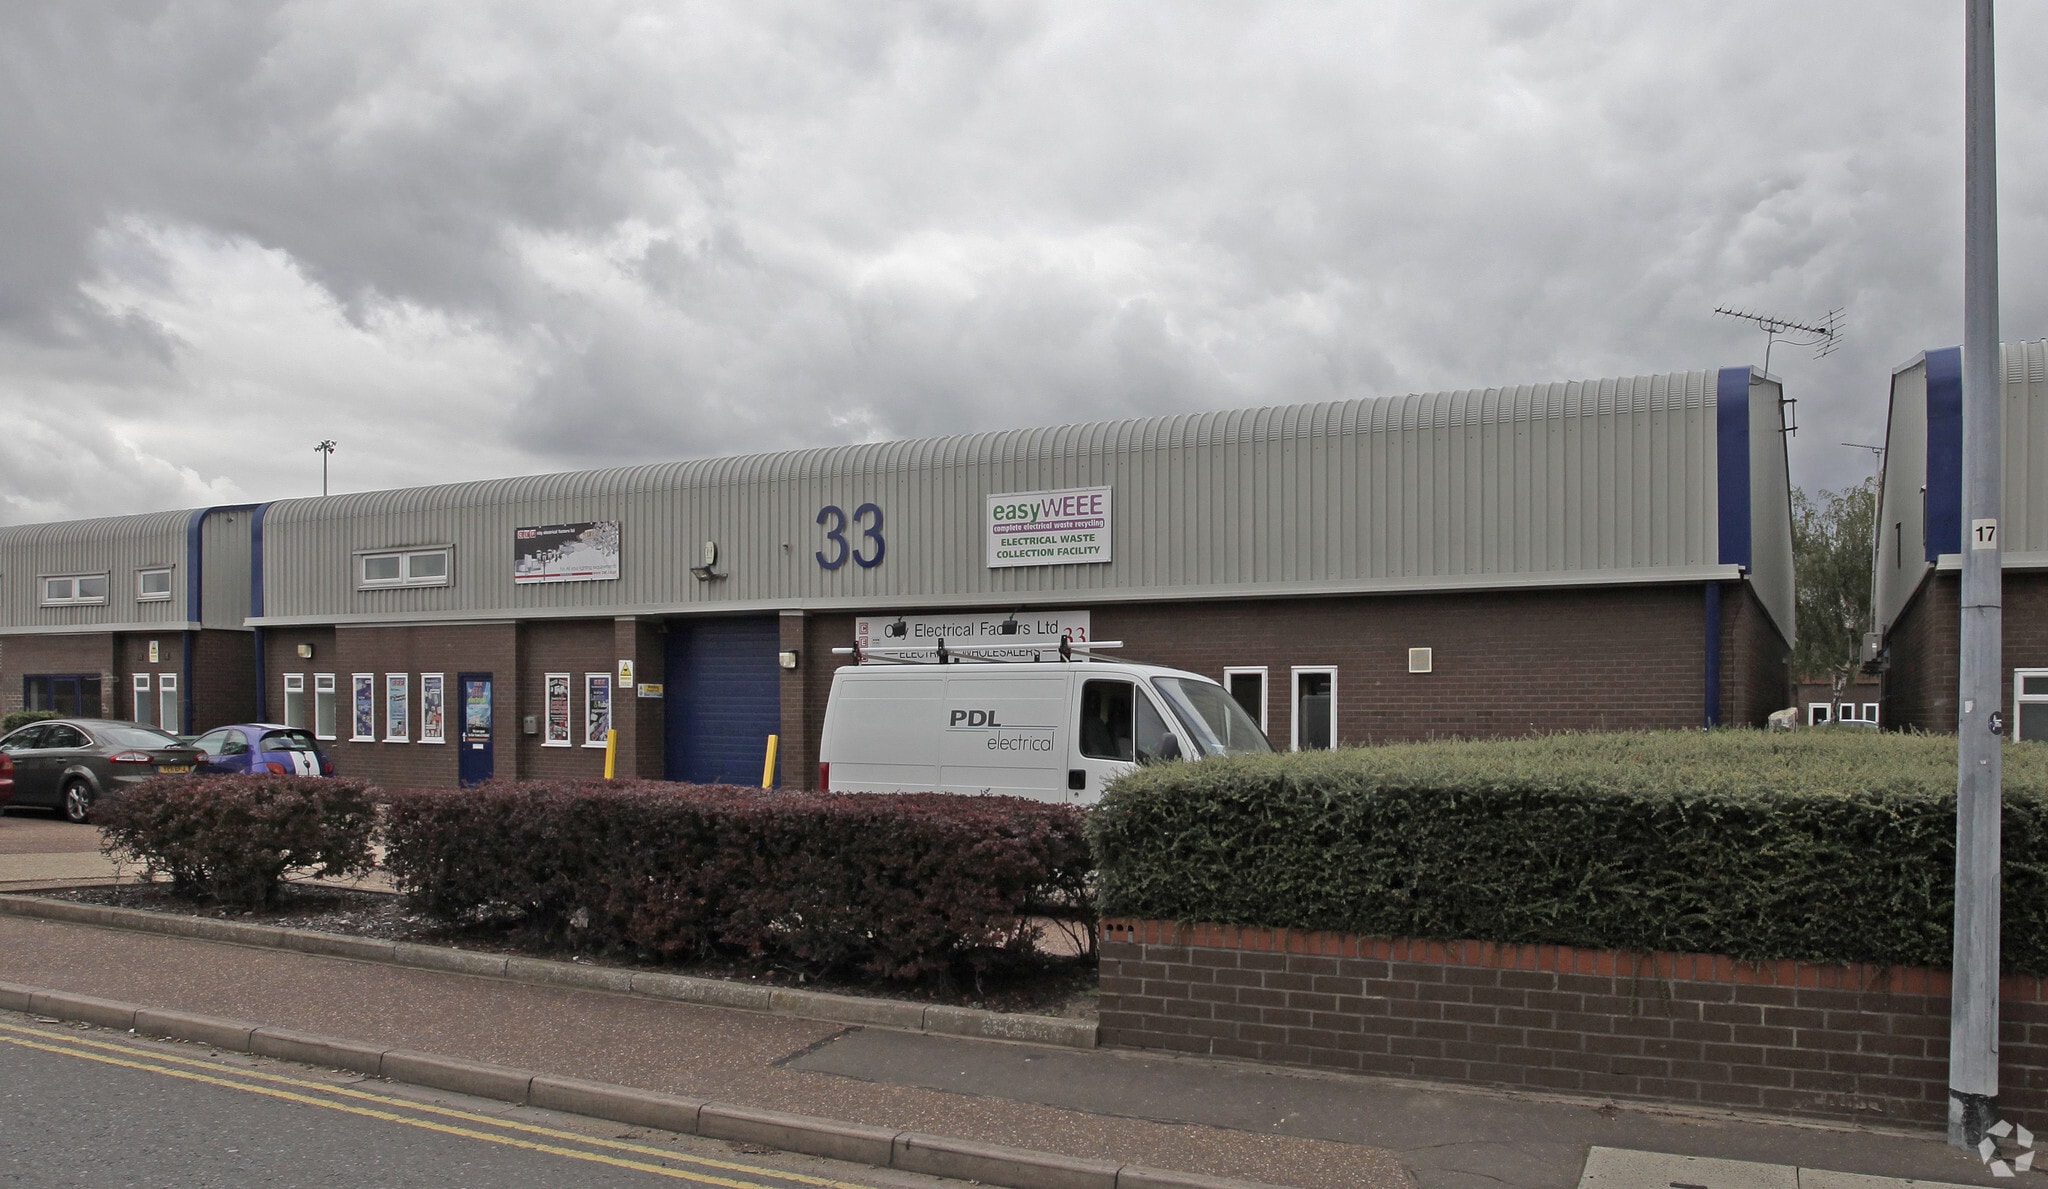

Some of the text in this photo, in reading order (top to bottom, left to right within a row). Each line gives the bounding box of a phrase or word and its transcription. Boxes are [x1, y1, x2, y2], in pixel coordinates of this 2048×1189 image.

[993, 494, 1104, 523] easyWEEE
[993, 519, 1104, 534] complete electrical waste recycling
[1975, 526, 1995, 541] 17
[816, 503, 885, 570] 33
[1001, 534, 1096, 546] ELECTRICAL WASTE
[996, 546, 1101, 558] COLLECTION FACILITY
[915, 622, 974, 637] Electrical
[980, 621, 1031, 636] Facrs
[1037, 620, 1058, 635] Ltd
[949, 710, 1001, 727] PDL
[987, 730, 1055, 751] electrical
